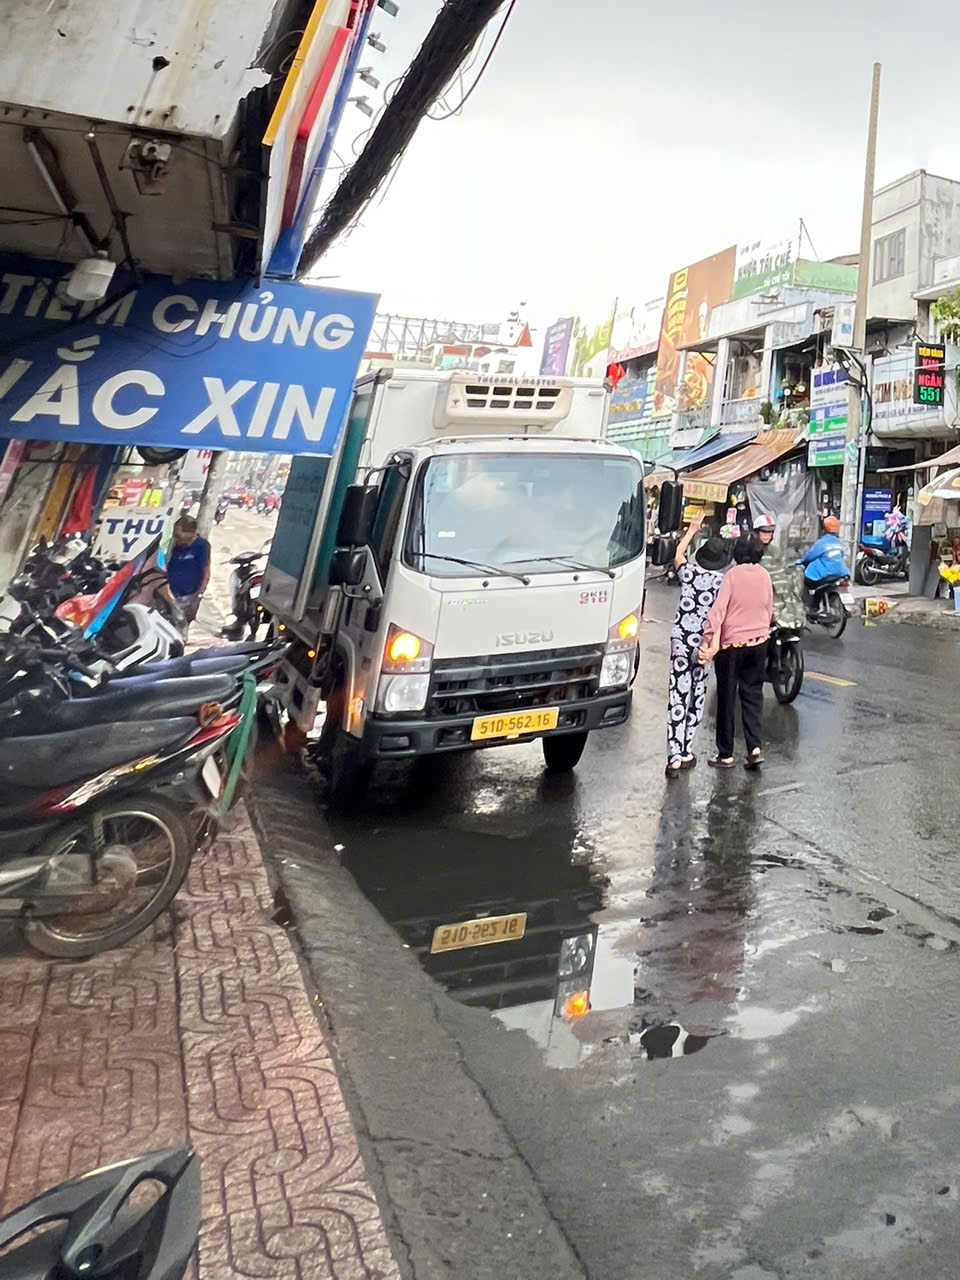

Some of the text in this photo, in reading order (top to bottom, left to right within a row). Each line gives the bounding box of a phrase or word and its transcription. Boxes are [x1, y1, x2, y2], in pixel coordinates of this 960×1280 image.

[152, 291, 355, 351] CHỦNG
[918, 373, 943, 388] NGÂN
[920, 387, 940, 402] 551
[180, 376, 337, 442] XIN
[107, 515, 164, 535] THÚ
[122, 537, 139, 553] Y
[495, 631, 555, 648] ISUZU
[480, 713, 551, 735] 51D-562.16
